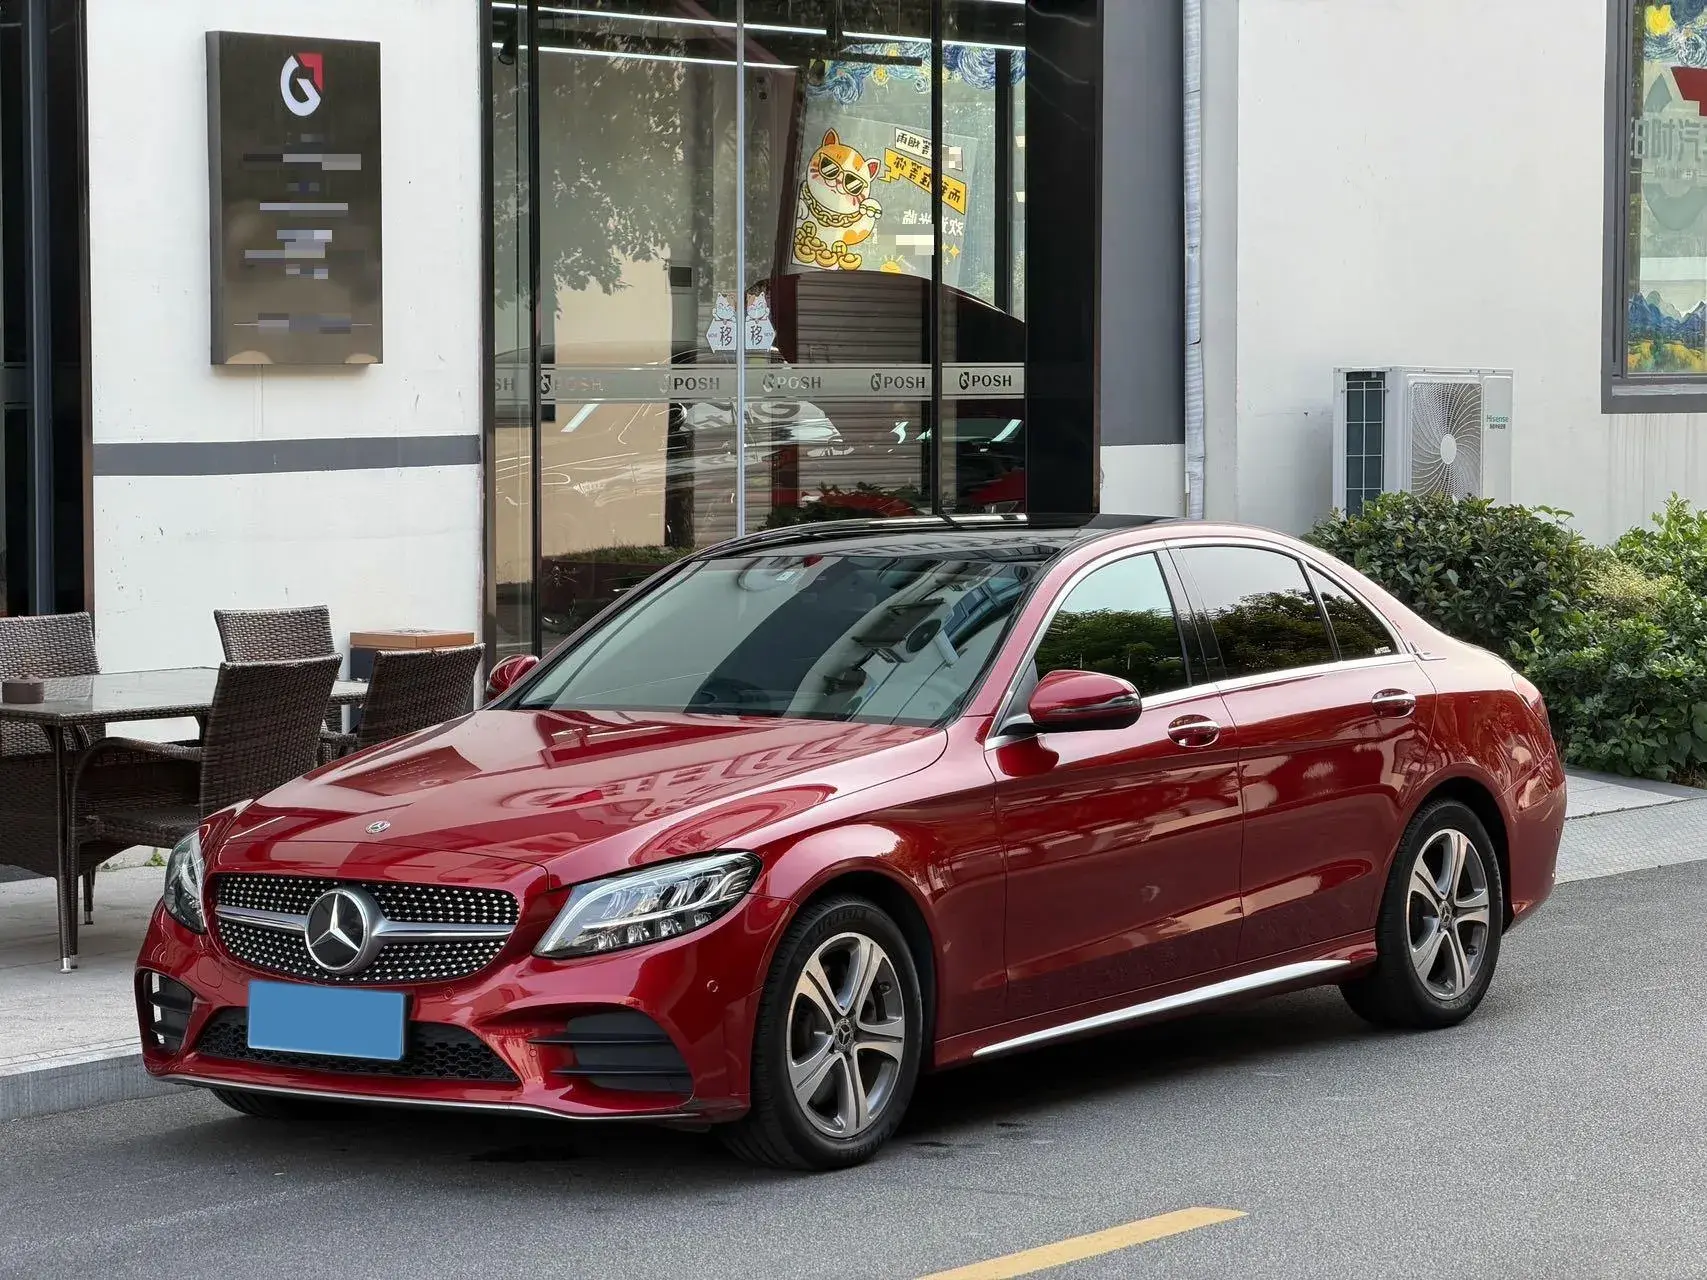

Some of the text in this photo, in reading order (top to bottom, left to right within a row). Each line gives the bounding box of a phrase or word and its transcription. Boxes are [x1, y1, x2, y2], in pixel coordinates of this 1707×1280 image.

[720, 326, 732, 346] 移
[751, 325, 763, 345] 移
[673, 377, 720, 391] POSH
[777, 376, 821, 389] POSH
[883, 376, 925, 389] POSH
[972, 374, 1012, 387] POSH
